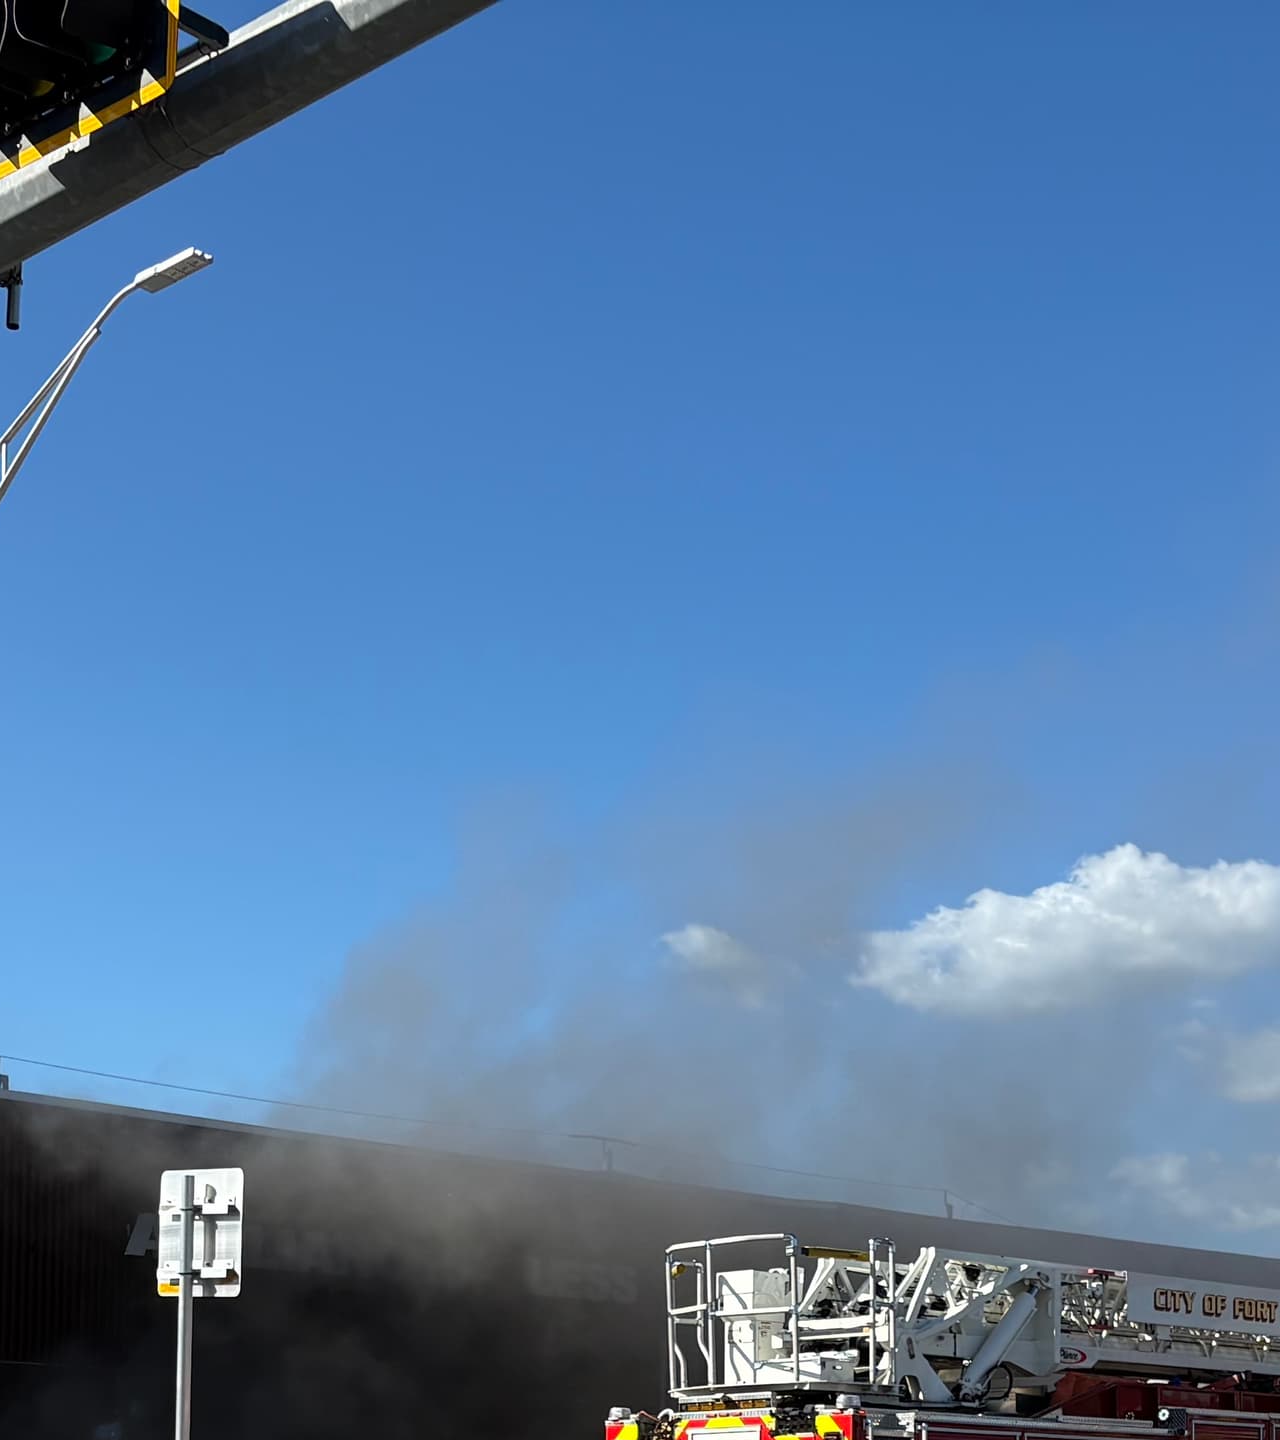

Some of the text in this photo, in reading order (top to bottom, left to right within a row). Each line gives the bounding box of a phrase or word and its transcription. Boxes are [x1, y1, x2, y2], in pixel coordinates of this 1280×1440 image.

[1154, 1288, 1197, 1314] CITY
[1202, 1294, 1227, 1318] OF
[1233, 1297, 1279, 1324] FORT
